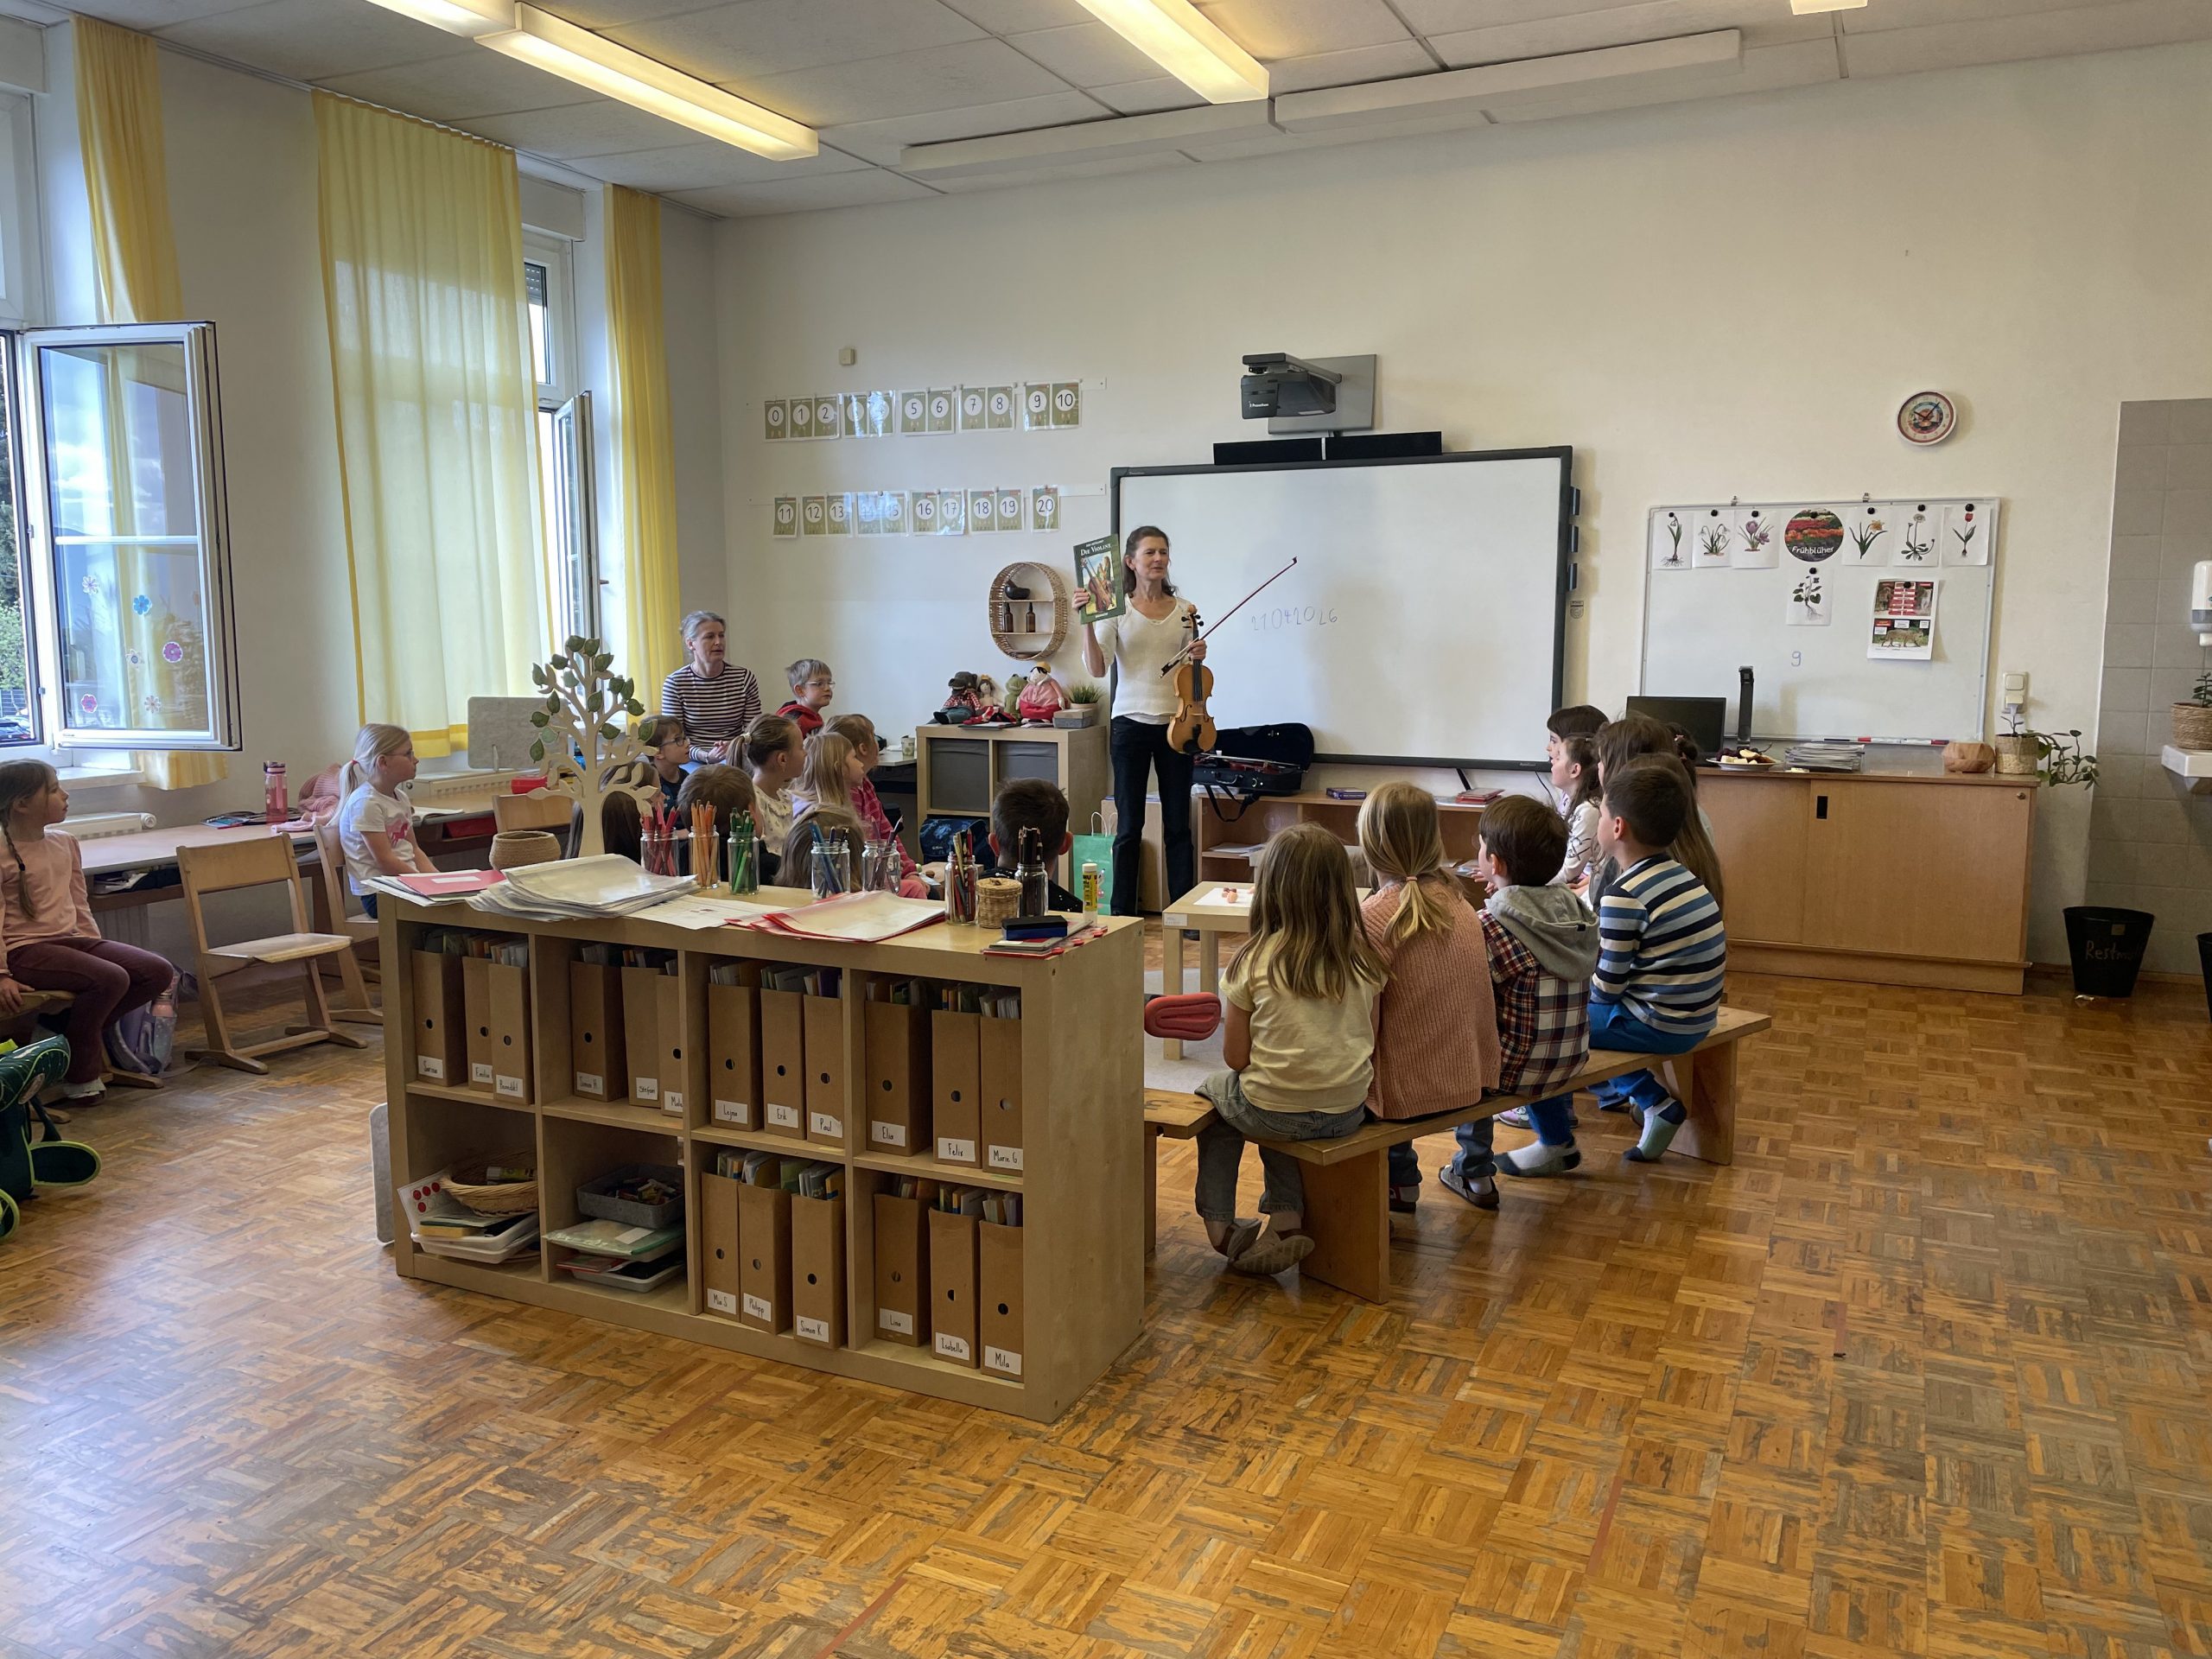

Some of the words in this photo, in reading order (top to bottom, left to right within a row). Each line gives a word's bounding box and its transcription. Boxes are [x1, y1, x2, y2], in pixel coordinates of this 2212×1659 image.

[969, 397, 977, 411] 7
[996, 397, 1004, 410] 8
[1033, 395, 1041, 408] 9
[1057, 393, 1074, 407] 10
[822, 406, 830, 420] 2
[911, 402, 918, 416] 5
[936, 400, 944, 414] 6
[772, 410, 779, 423] 0
[798, 408, 804, 421] 1
[807, 505, 821, 519] 12
[830, 505, 844, 518] 13
[918, 502, 932, 516] 16
[944, 501, 957, 515] 17
[975, 501, 989, 514] 18
[1001, 500, 1016, 513] 19
[1038, 499, 1054, 512] 20
[779, 507, 791, 520] 11
[1791, 545, 1834, 554] Frühblüher
[948, 1142, 963, 1157] Felix
